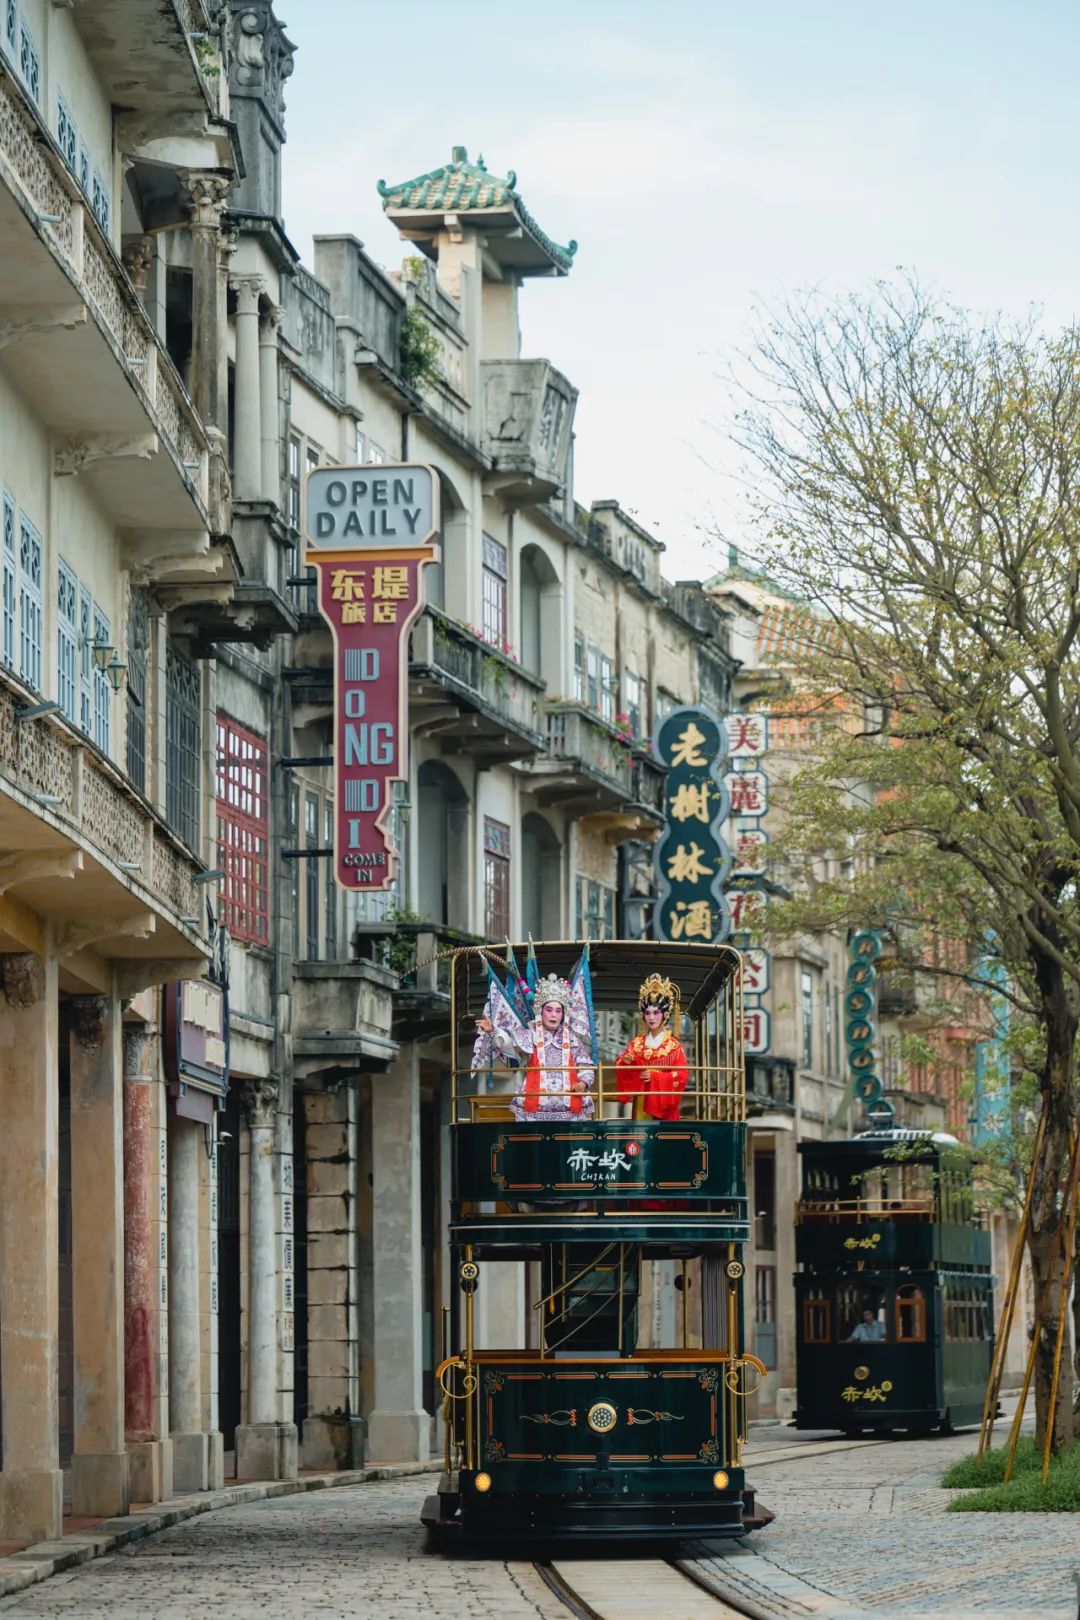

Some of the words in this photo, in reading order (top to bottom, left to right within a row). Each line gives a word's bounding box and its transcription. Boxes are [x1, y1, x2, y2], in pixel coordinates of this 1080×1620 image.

[326, 478, 414, 507] OPEN
[316, 508, 421, 537] DAILY
[331, 566, 409, 600] 东堤
[341, 602, 398, 625] 旅店
[343, 852, 385, 866] COME
[356, 869, 373, 882] IN
[566, 1148, 632, 1171] 赤坎
[580, 1171, 616, 1181] CHIKAN
[843, 1236, 878, 1250] 赤坎
[841, 1385, 887, 1403] 赤坎
